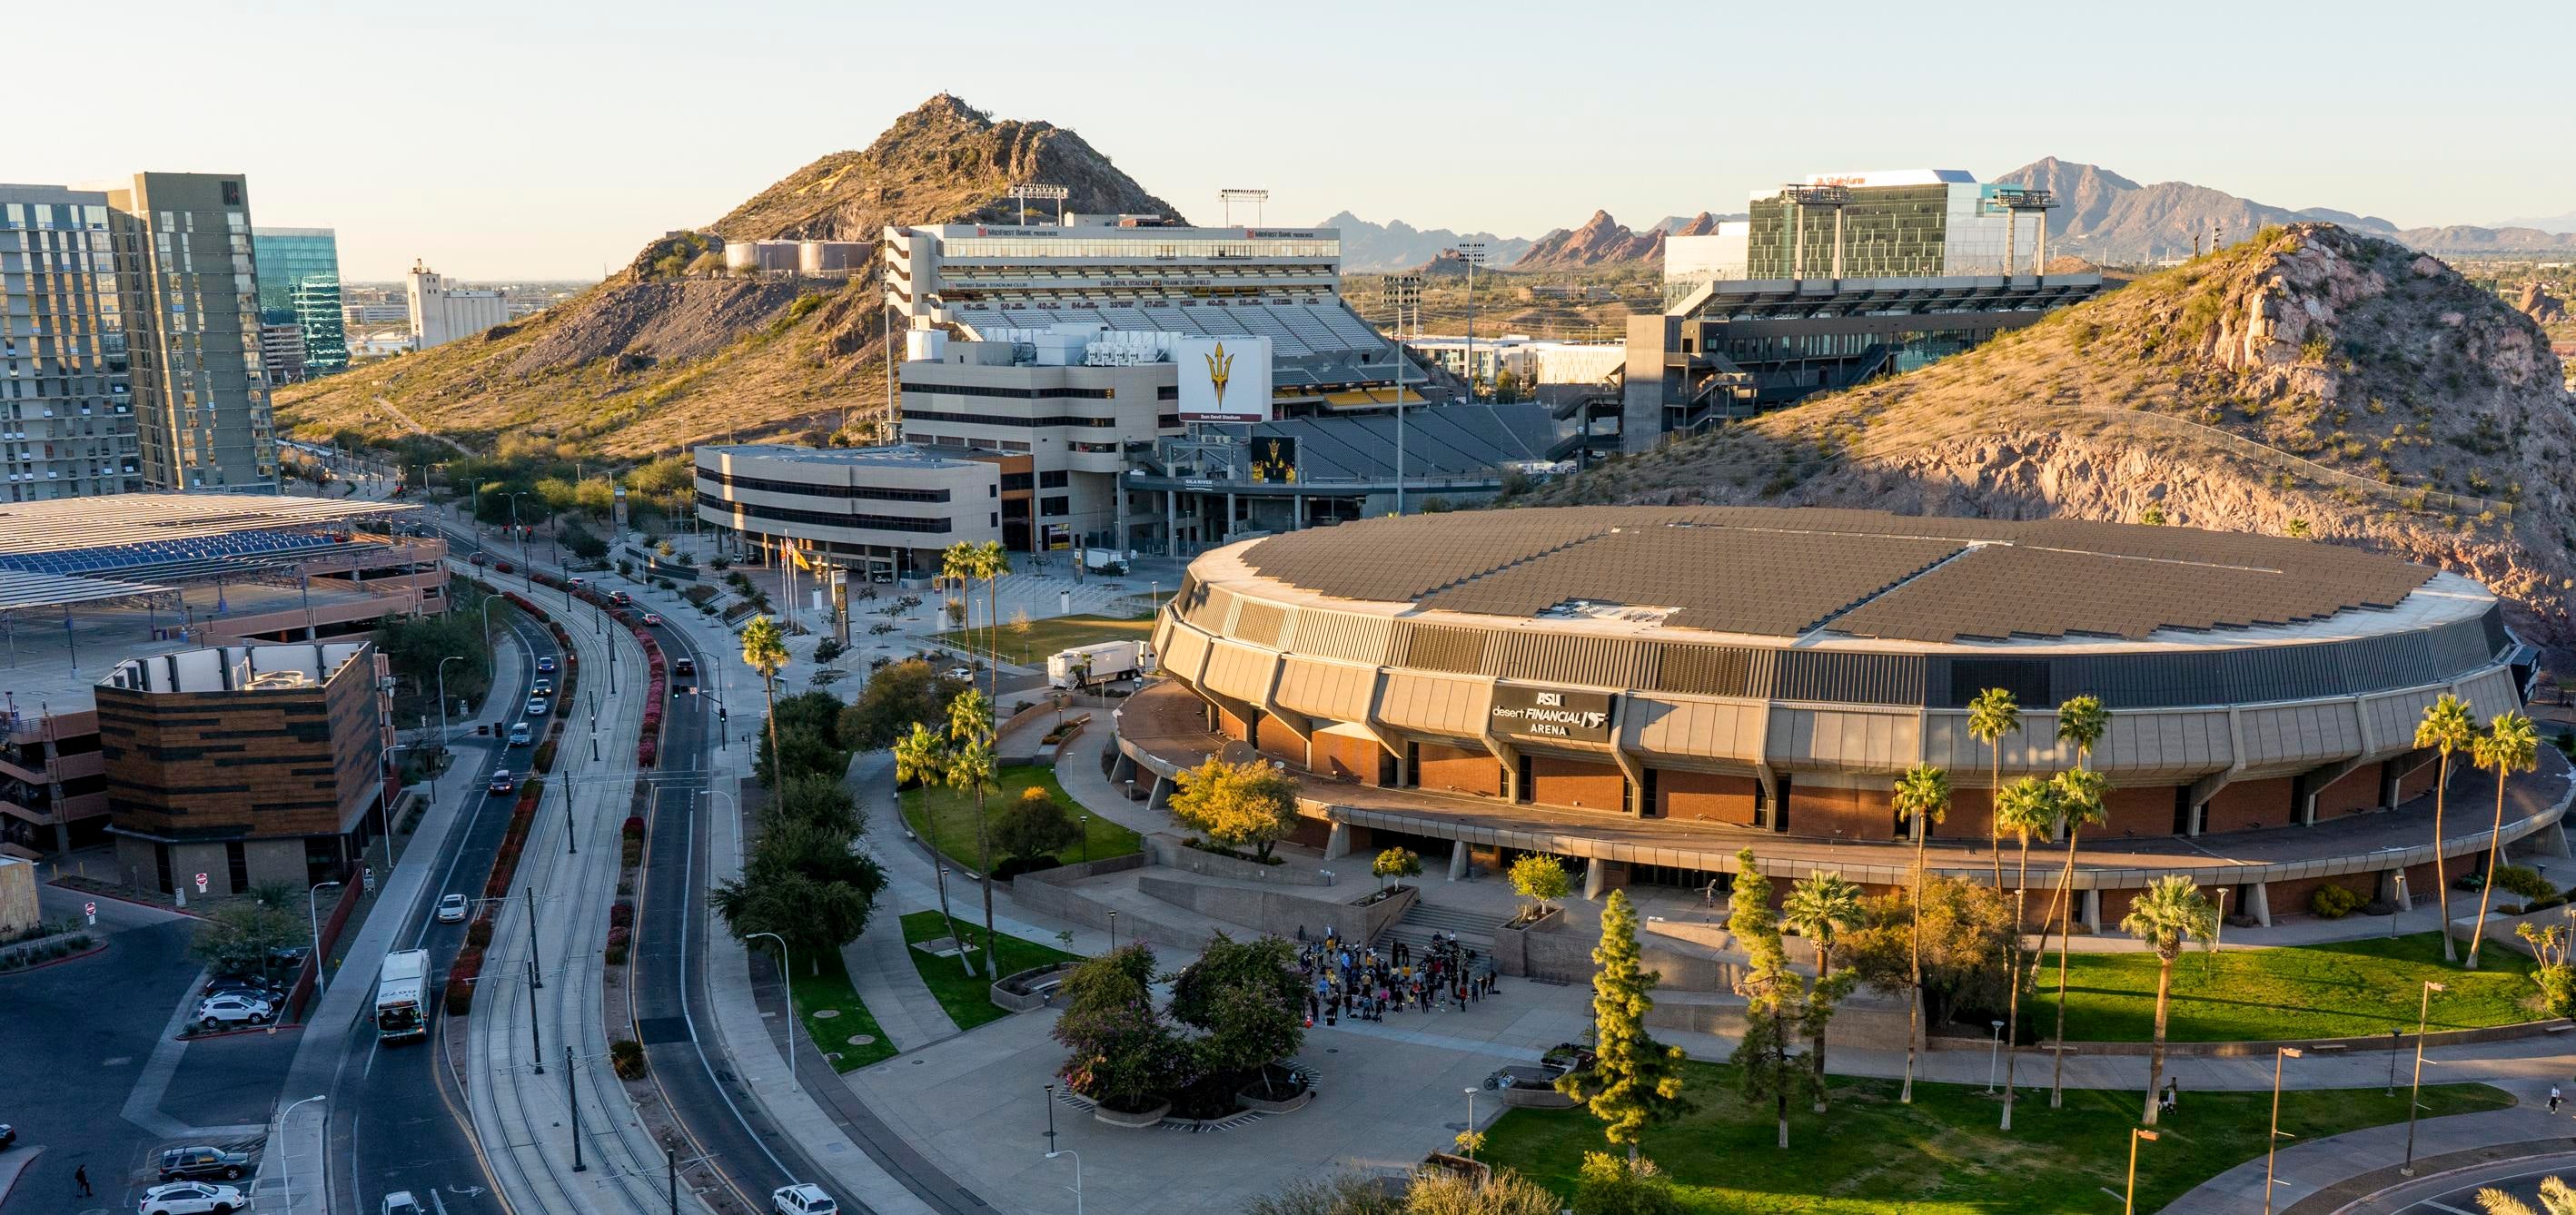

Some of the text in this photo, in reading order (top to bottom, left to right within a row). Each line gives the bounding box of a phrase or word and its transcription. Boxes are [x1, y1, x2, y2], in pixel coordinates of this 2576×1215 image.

[1536, 692, 1561, 706] ASU
[1492, 706, 1580, 724] desert FINANCIAL
[1531, 724, 1567, 736] ARENA
